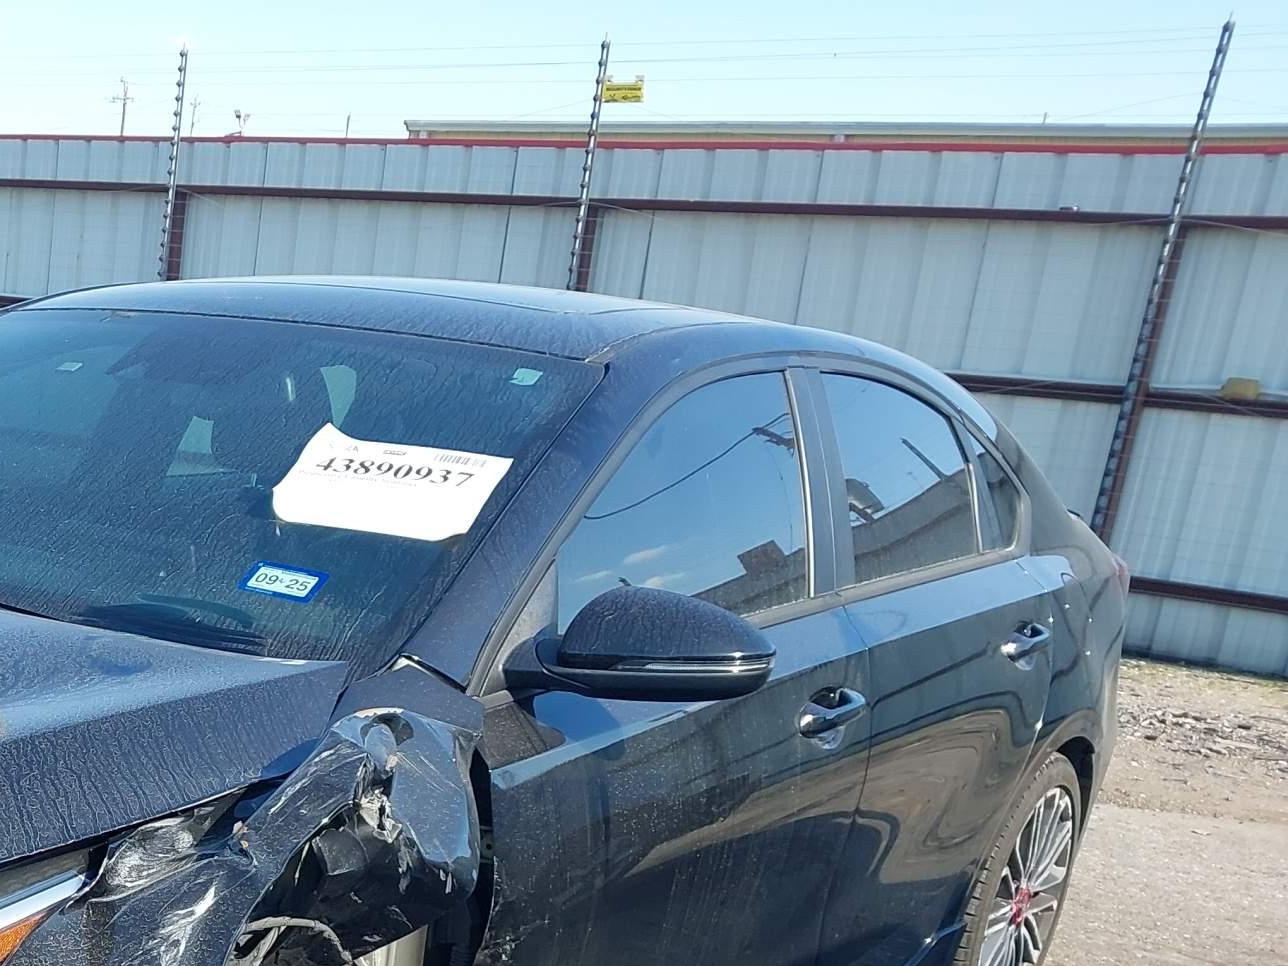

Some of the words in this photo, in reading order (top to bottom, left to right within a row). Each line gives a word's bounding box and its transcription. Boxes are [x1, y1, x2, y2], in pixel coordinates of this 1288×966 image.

[315, 456, 476, 488] 43890937
[255, 572, 279, 585] 09
[284, 578, 312, 592] 25
